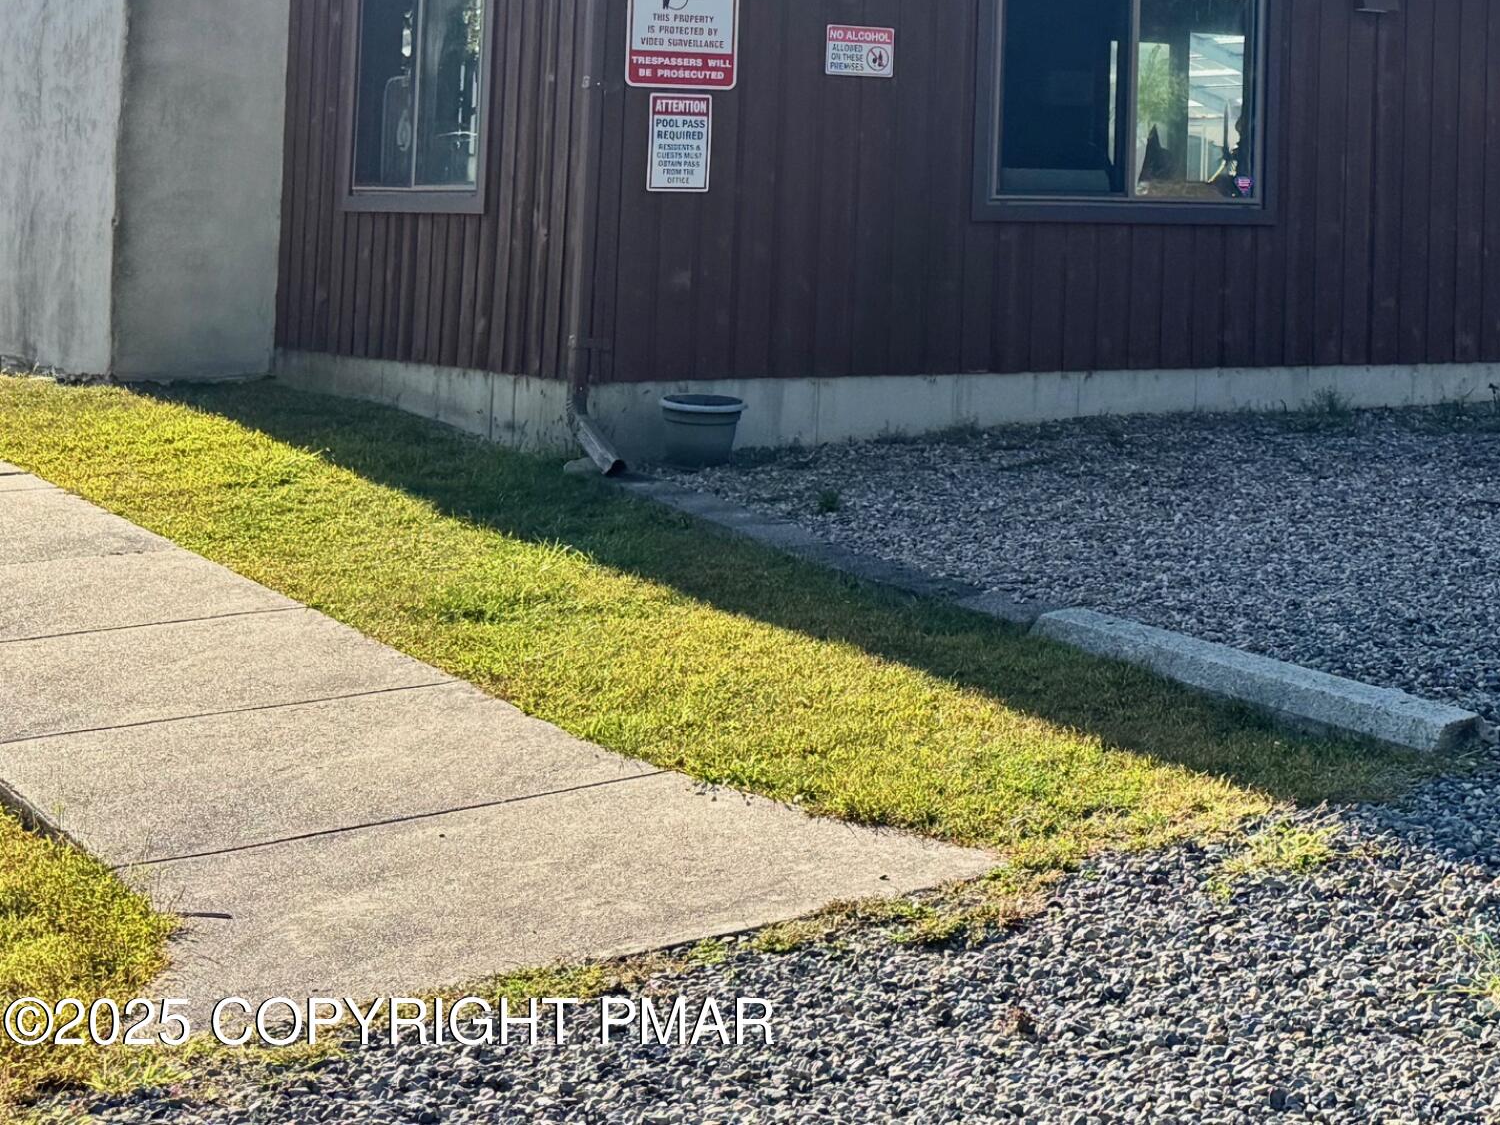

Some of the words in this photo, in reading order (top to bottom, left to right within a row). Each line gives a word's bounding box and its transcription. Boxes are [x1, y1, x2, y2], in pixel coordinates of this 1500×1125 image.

[653, 13, 670, 22] THIS
[674, 14, 714, 23] PROPERTY
[648, 25, 655, 34] IS
[659, 26, 704, 35] PROTECTED
[708, 28, 718, 36] BY
[830, 29, 844, 40] NO
[847, 31, 891, 42] ALCOHOL
[641, 37, 664, 46] VIDEO
[668, 38, 724, 48] SURVEILLANCE
[632, 56, 703, 67] TRESPASSERS
[708, 59, 732, 67] WILL
[843, 53, 864, 62] THESE
[638, 68, 652, 77] BE
[657, 69, 724, 79] PROSECUTED
[655, 100, 707, 113] ATTENTION
[656, 119, 680, 127] POOL
[682, 119, 705, 128] PASS
[657, 130, 703, 140] REQUIRED
